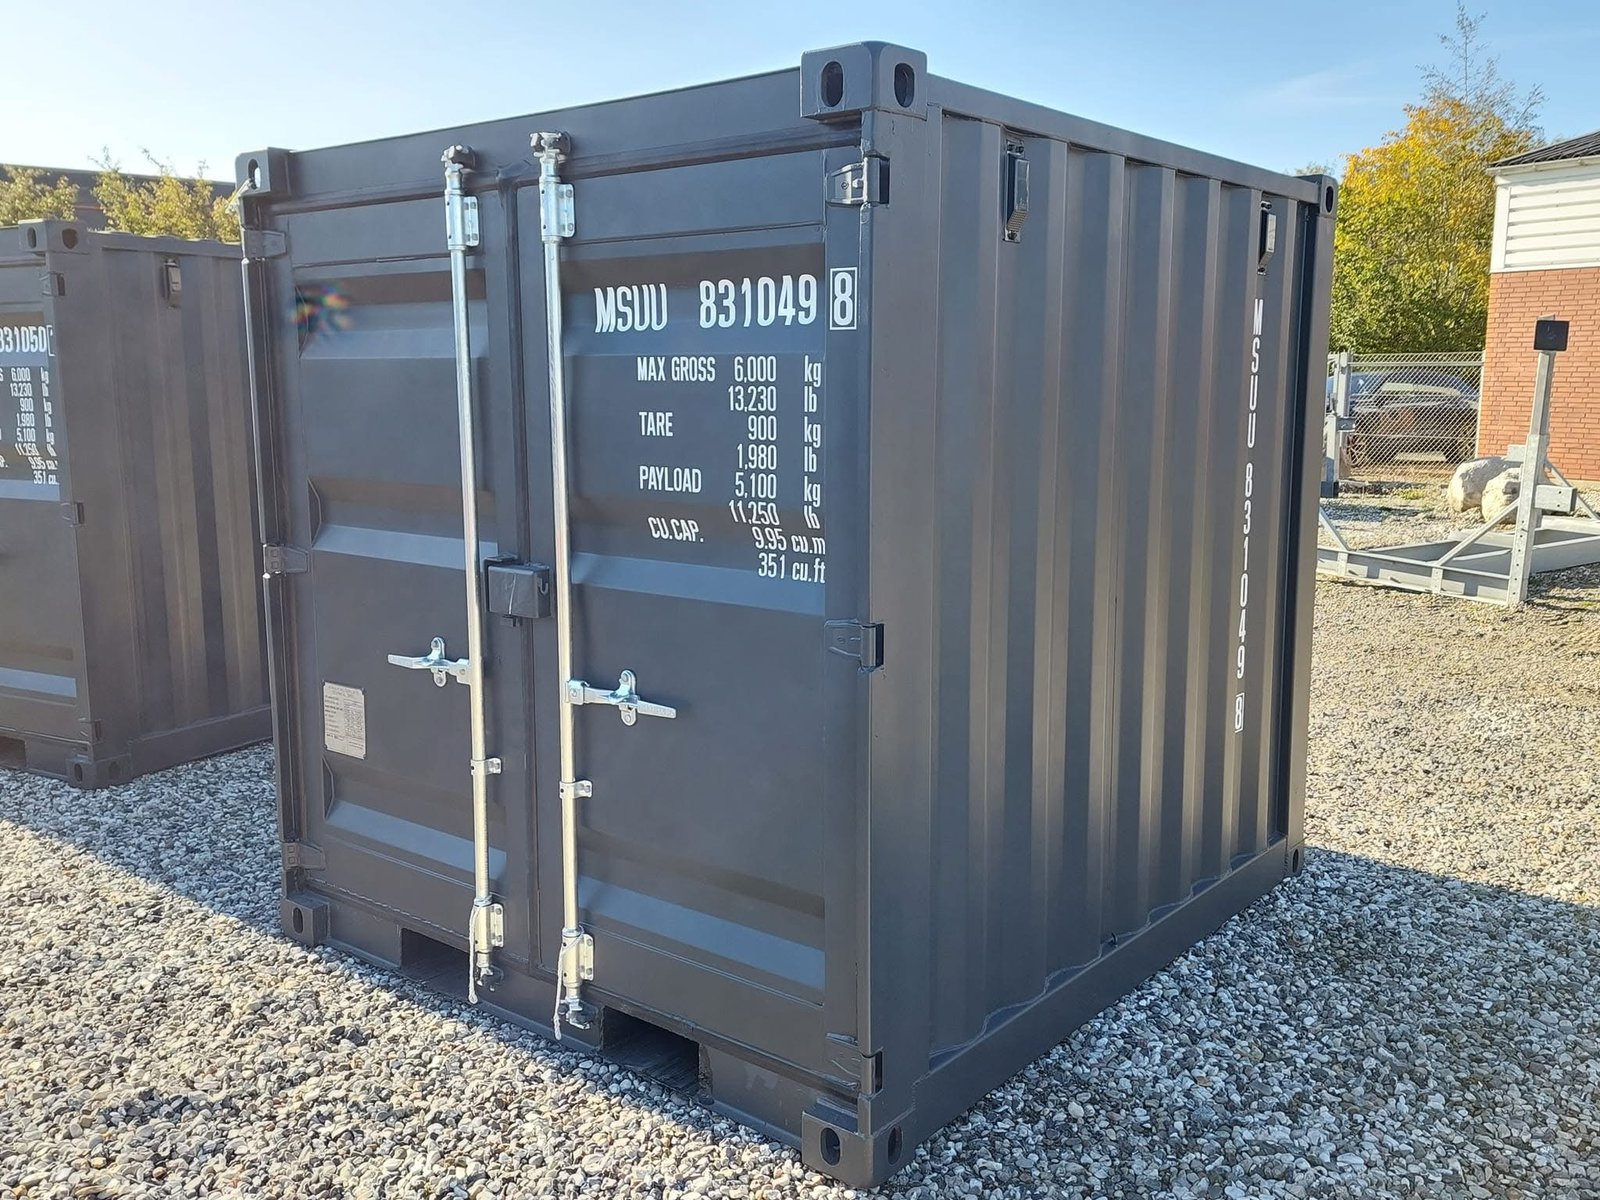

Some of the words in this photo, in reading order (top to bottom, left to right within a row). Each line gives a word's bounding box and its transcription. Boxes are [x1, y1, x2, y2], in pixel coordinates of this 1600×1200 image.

[594, 284, 668, 333] MSUU
[699, 274, 817, 328] 831049
[832, 272, 854, 327] 8
[637, 357, 666, 381] MAX
[671, 357, 716, 381] GROSS
[734, 356, 777, 383] 6,000
[804, 356, 821, 387] kg
[1247, 299, 1264, 449] MSUU
[728, 386, 777, 412] 13,230
[804, 386, 817, 412] lb
[639, 412, 673, 437] TARE
[747, 416, 777, 441] 900
[804, 416, 821, 447] kg
[737, 445, 777, 470] 1,980
[804, 446, 817, 472] lb
[34, 471, 45, 485] 351
[639, 466, 701, 493] PAYLOAD
[735, 474, 777, 499] 5,100
[804, 477, 821, 507] kg
[804, 506, 820, 529] lb
[648, 517, 704, 543] CU.CAP.
[754, 529, 787, 550] 9.95
[792, 535, 826, 555] cu.m
[758, 554, 785, 579] 351
[792, 556, 826, 583] cu.ft
[1236, 463, 1253, 679] 831049
